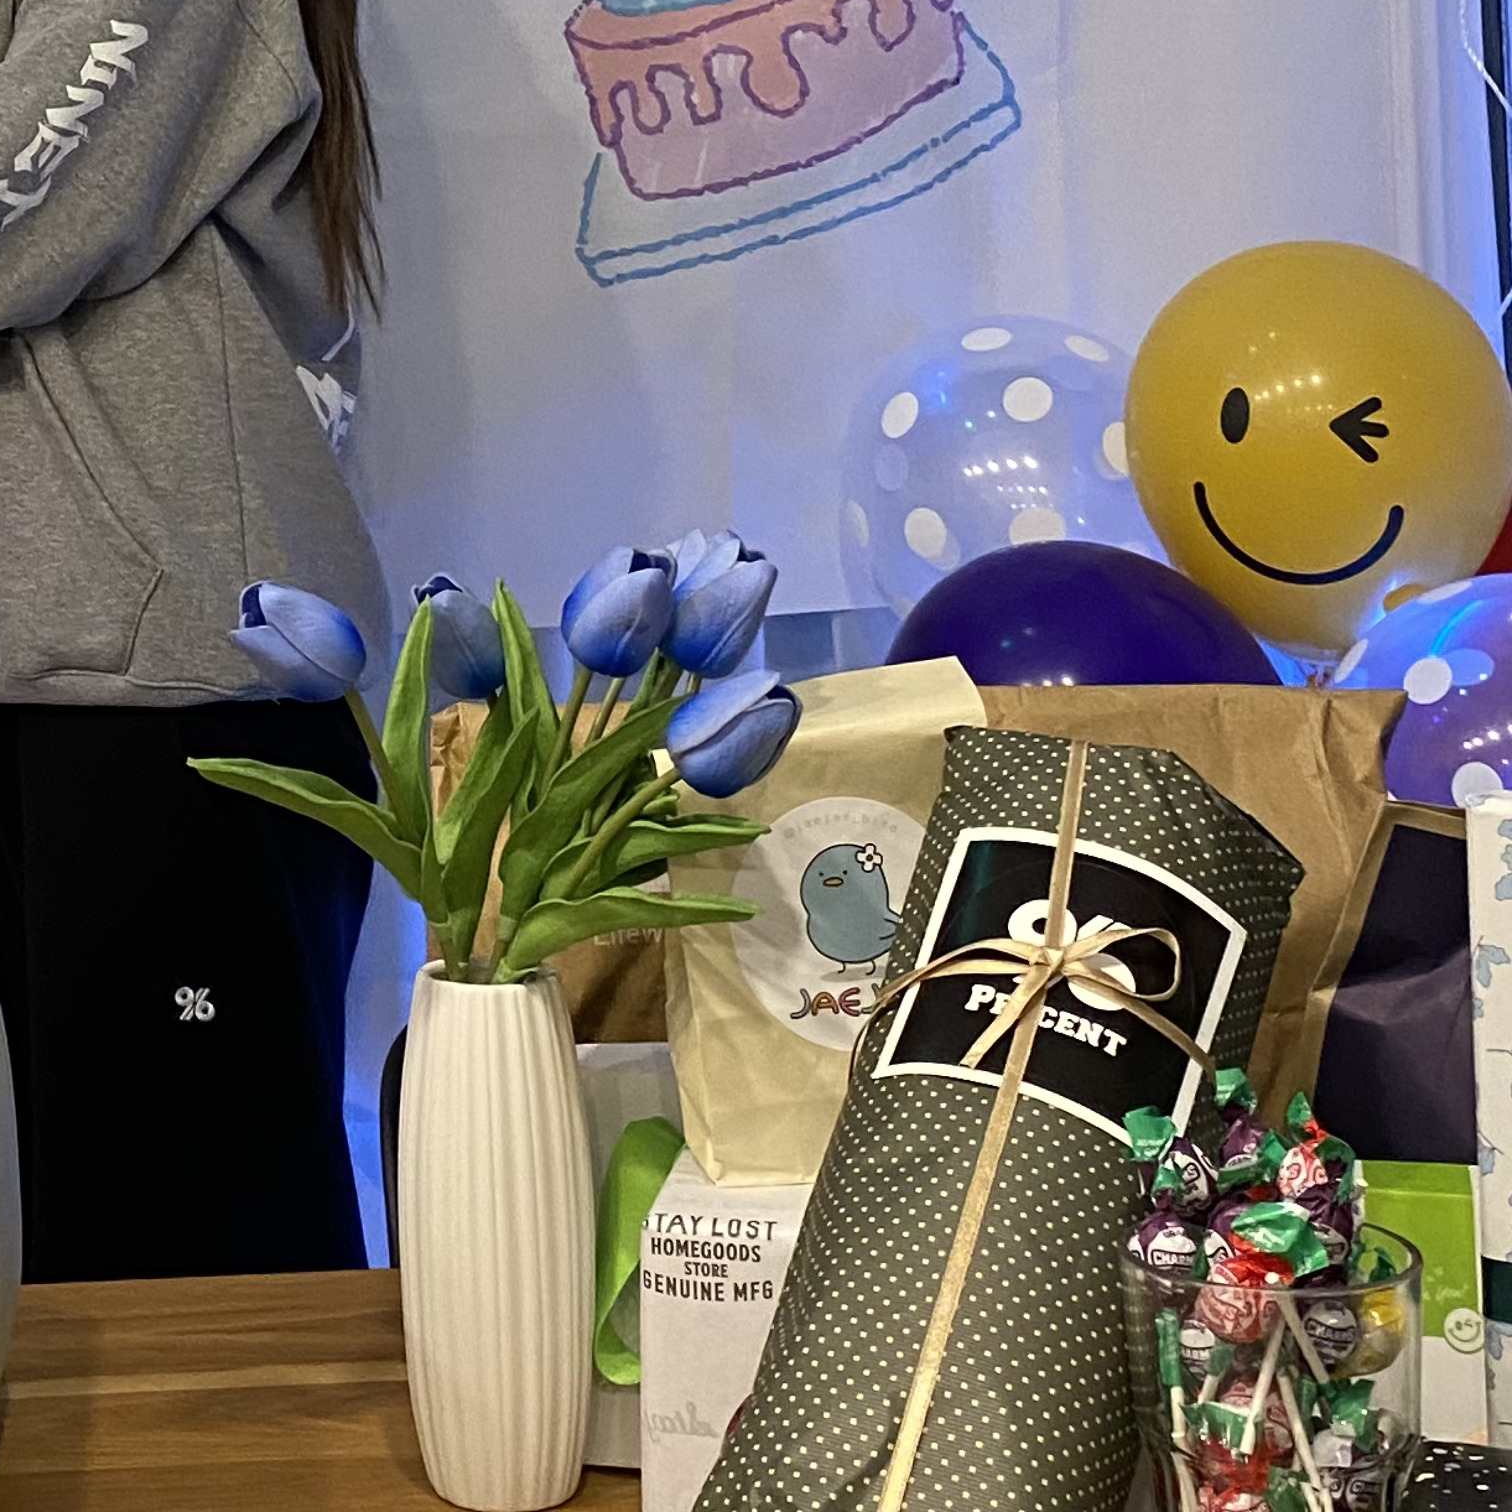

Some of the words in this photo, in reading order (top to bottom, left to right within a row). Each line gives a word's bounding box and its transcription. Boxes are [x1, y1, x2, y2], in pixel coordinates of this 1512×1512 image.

[964, 983, 1128, 1059] PECENT
[711, 1217, 779, 1241] LOST
[651, 1237, 762, 1263] HOMEGOODS
[684, 1261, 729, 1279] STORE
[643, 1269, 725, 1303] GENUINE
[733, 1279, 774, 1302] MFG
